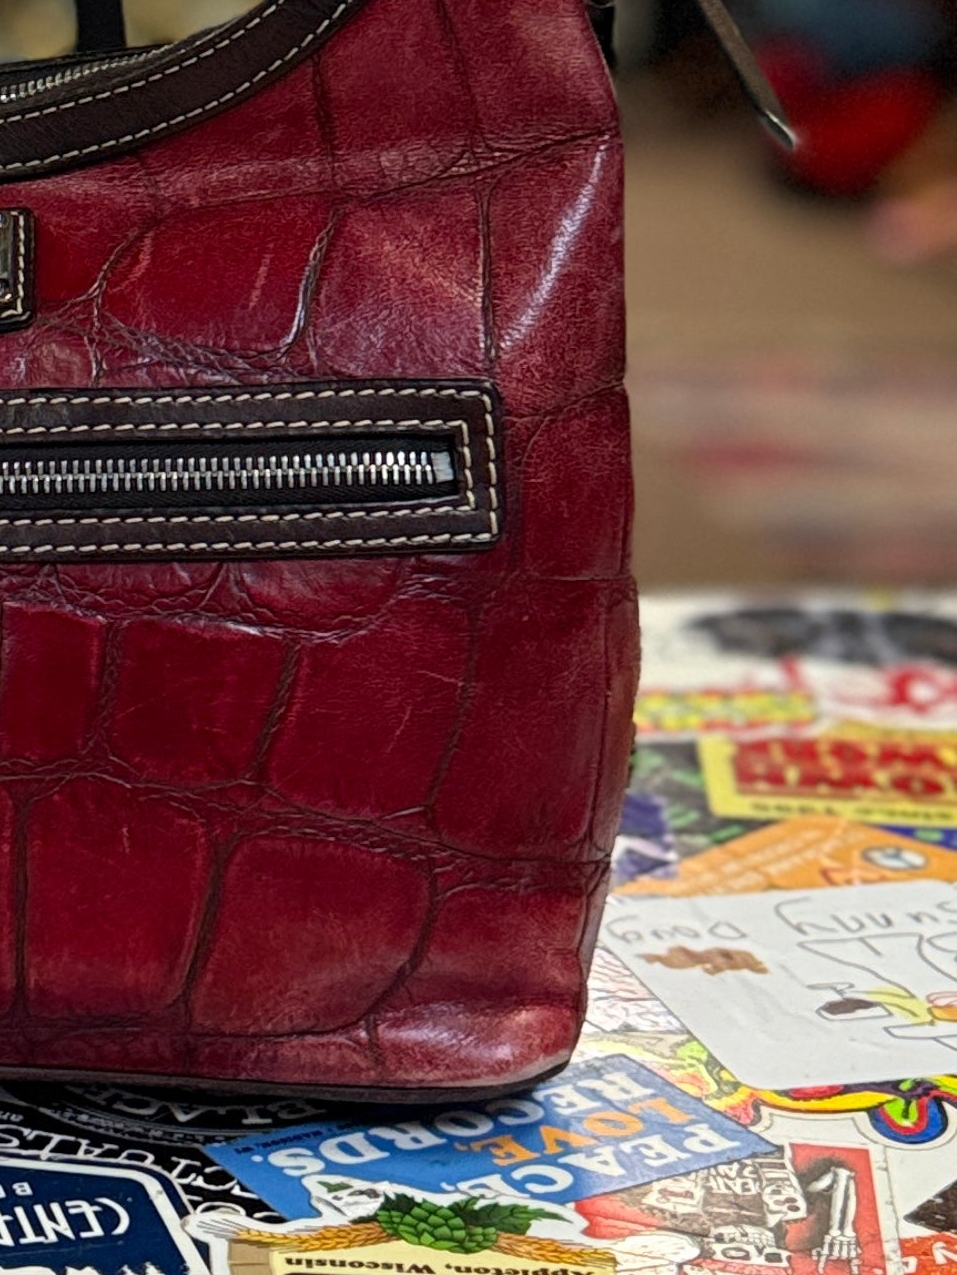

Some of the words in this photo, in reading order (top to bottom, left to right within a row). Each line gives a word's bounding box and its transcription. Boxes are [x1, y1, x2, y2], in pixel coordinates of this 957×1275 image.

[252, 1070, 656, 1178] RECORDS.
[455, 1098, 696, 1167] LOVE,
[438, 1122, 741, 1201] PEACE,
[284, 1258, 437, 1275] Wisconsin
